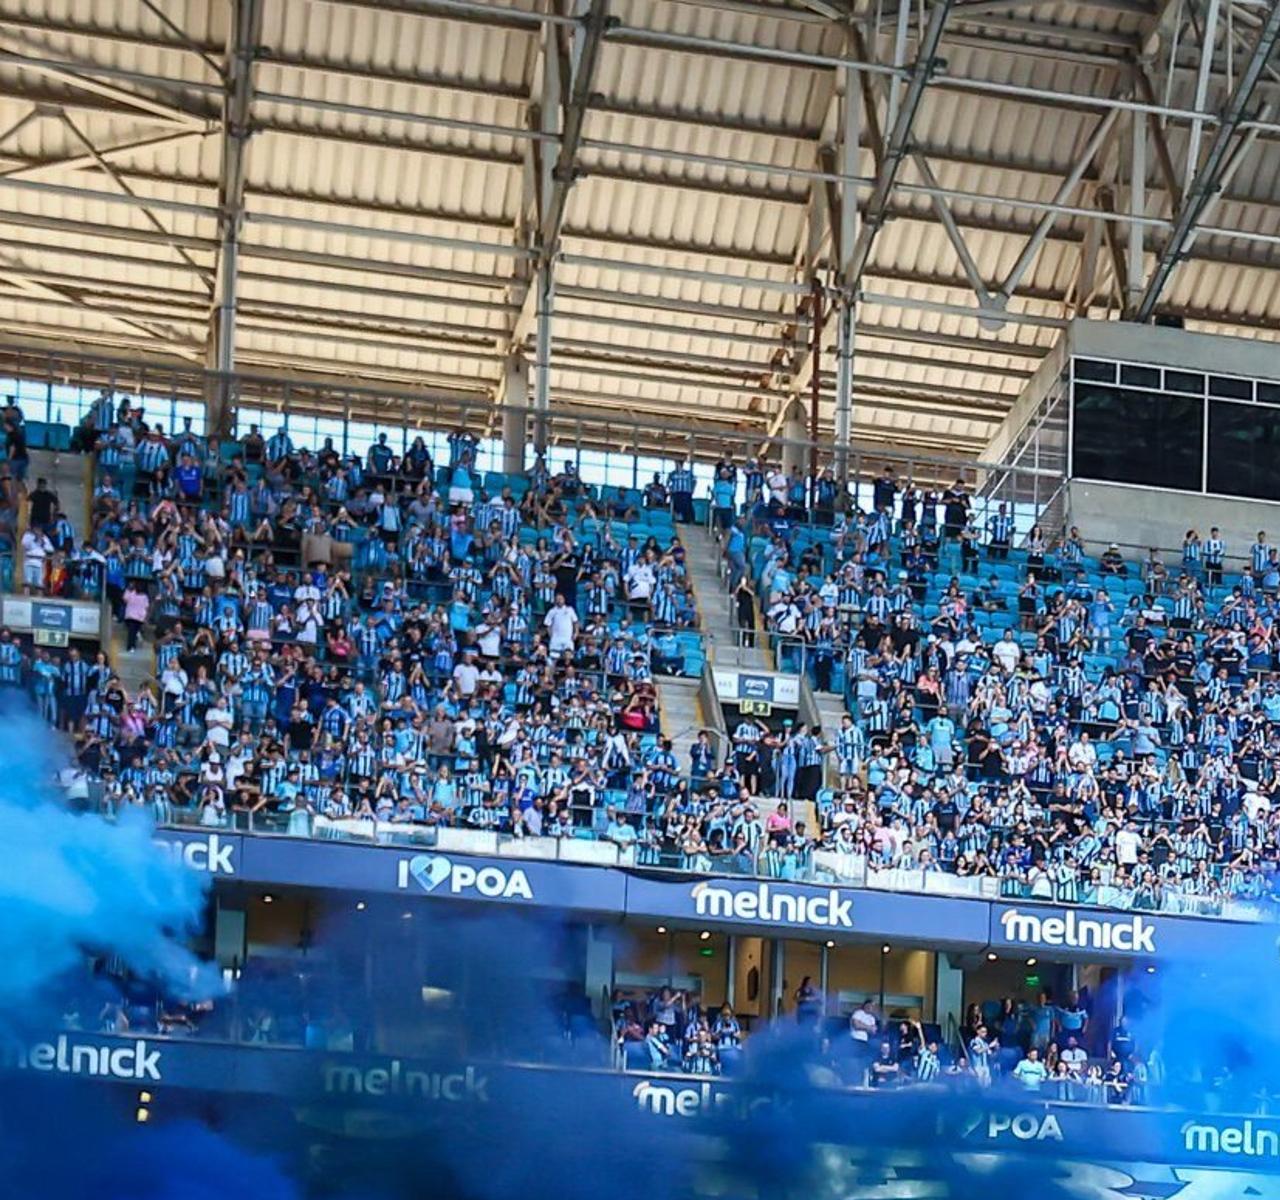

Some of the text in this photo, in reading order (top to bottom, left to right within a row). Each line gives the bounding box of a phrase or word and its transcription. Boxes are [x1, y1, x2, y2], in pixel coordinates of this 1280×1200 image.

[451, 864, 534, 900] POA
[691, 881, 854, 928] melnick
[1001, 909, 1156, 953] melnick
[16, 1034, 162, 1081] elnick
[322, 1058, 489, 1102] melnick
[988, 1114, 1064, 1142] POA
